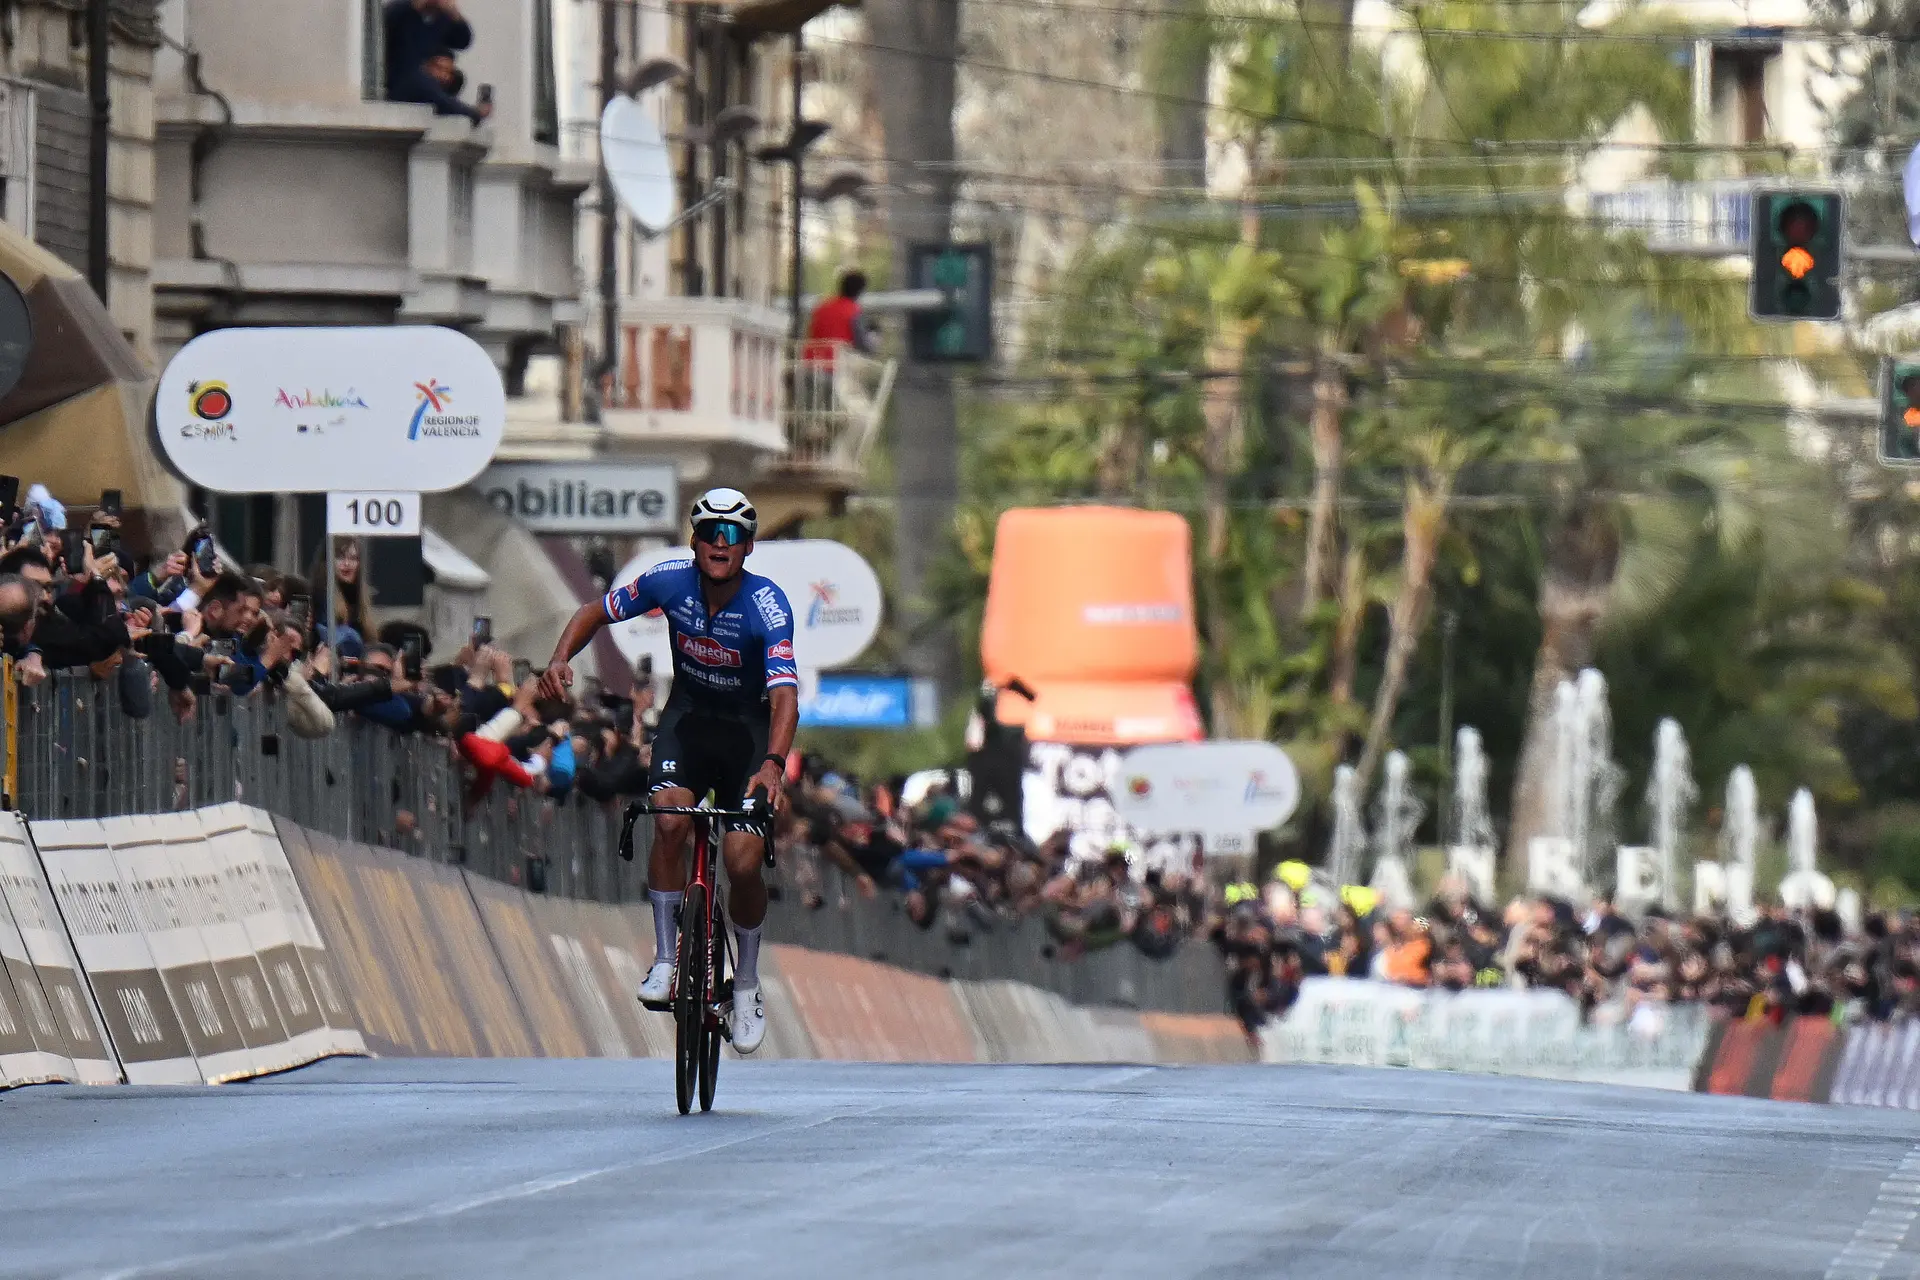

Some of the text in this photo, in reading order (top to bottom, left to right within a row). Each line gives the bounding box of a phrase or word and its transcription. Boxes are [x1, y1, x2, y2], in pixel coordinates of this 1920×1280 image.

[421, 427, 480, 437] VALENCIA
[424, 415, 463, 425] REGION
[346, 499, 403, 526] 100
[755, 586, 788, 629] Alpecin
[684, 639, 732, 664] Alpecin
